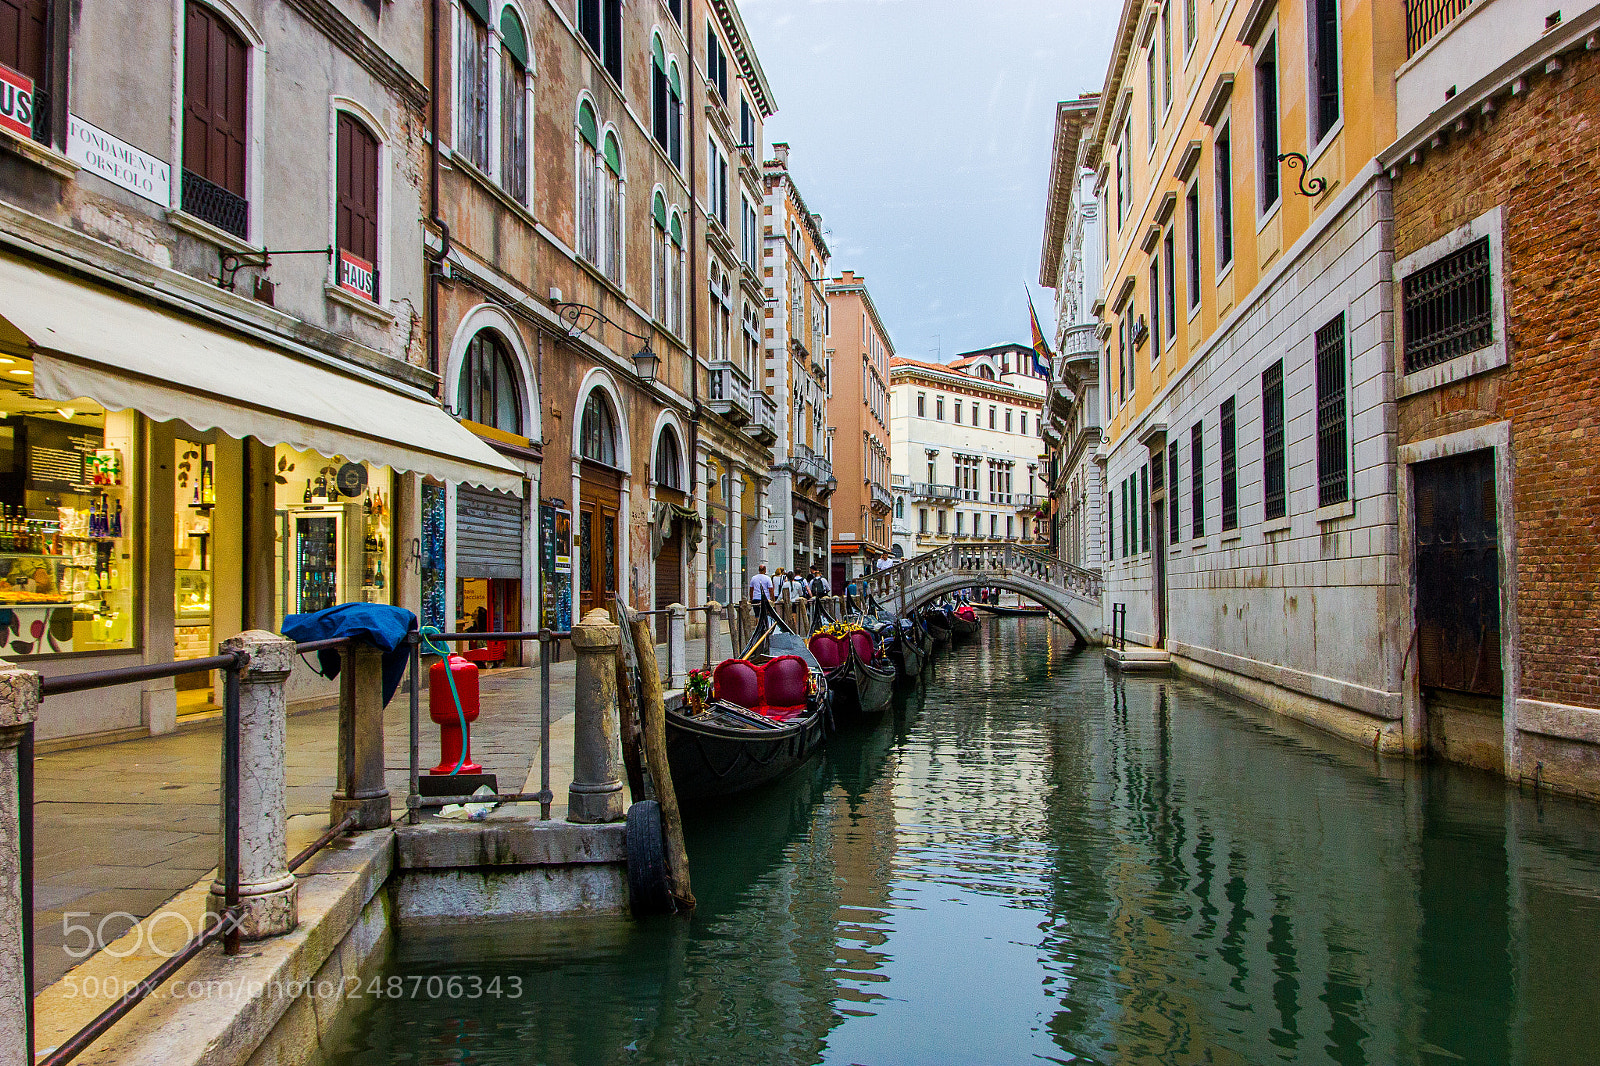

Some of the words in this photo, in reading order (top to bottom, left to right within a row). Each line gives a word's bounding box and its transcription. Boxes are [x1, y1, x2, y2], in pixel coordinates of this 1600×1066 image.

[71, 122, 166, 182] FONDAMENTA
[86, 150, 153, 192] ORSEOLO
[340, 260, 372, 294] HAUS
